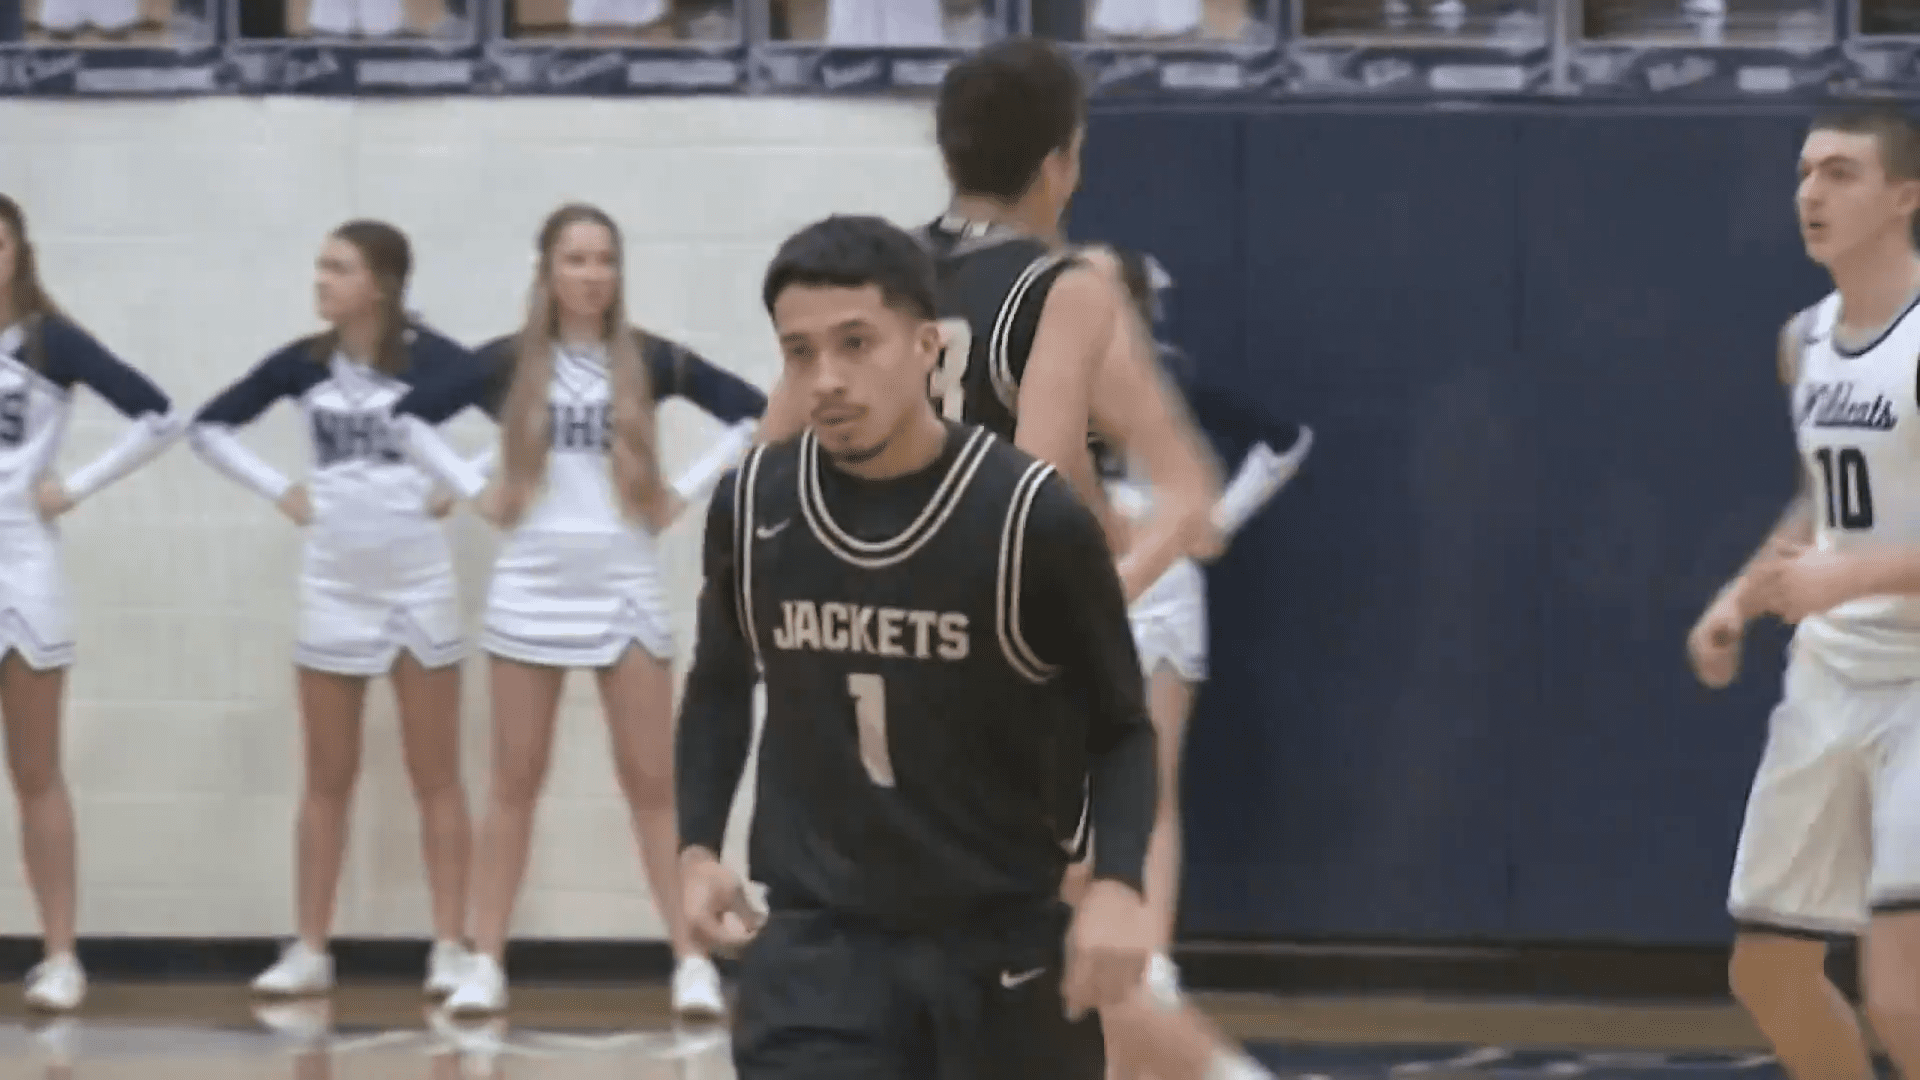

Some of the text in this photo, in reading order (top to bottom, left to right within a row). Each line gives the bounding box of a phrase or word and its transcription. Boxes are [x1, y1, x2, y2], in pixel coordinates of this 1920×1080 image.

[1815, 448, 1873, 528] 10
[774, 601, 970, 661] JACKETS
[847, 673, 895, 788] 1
